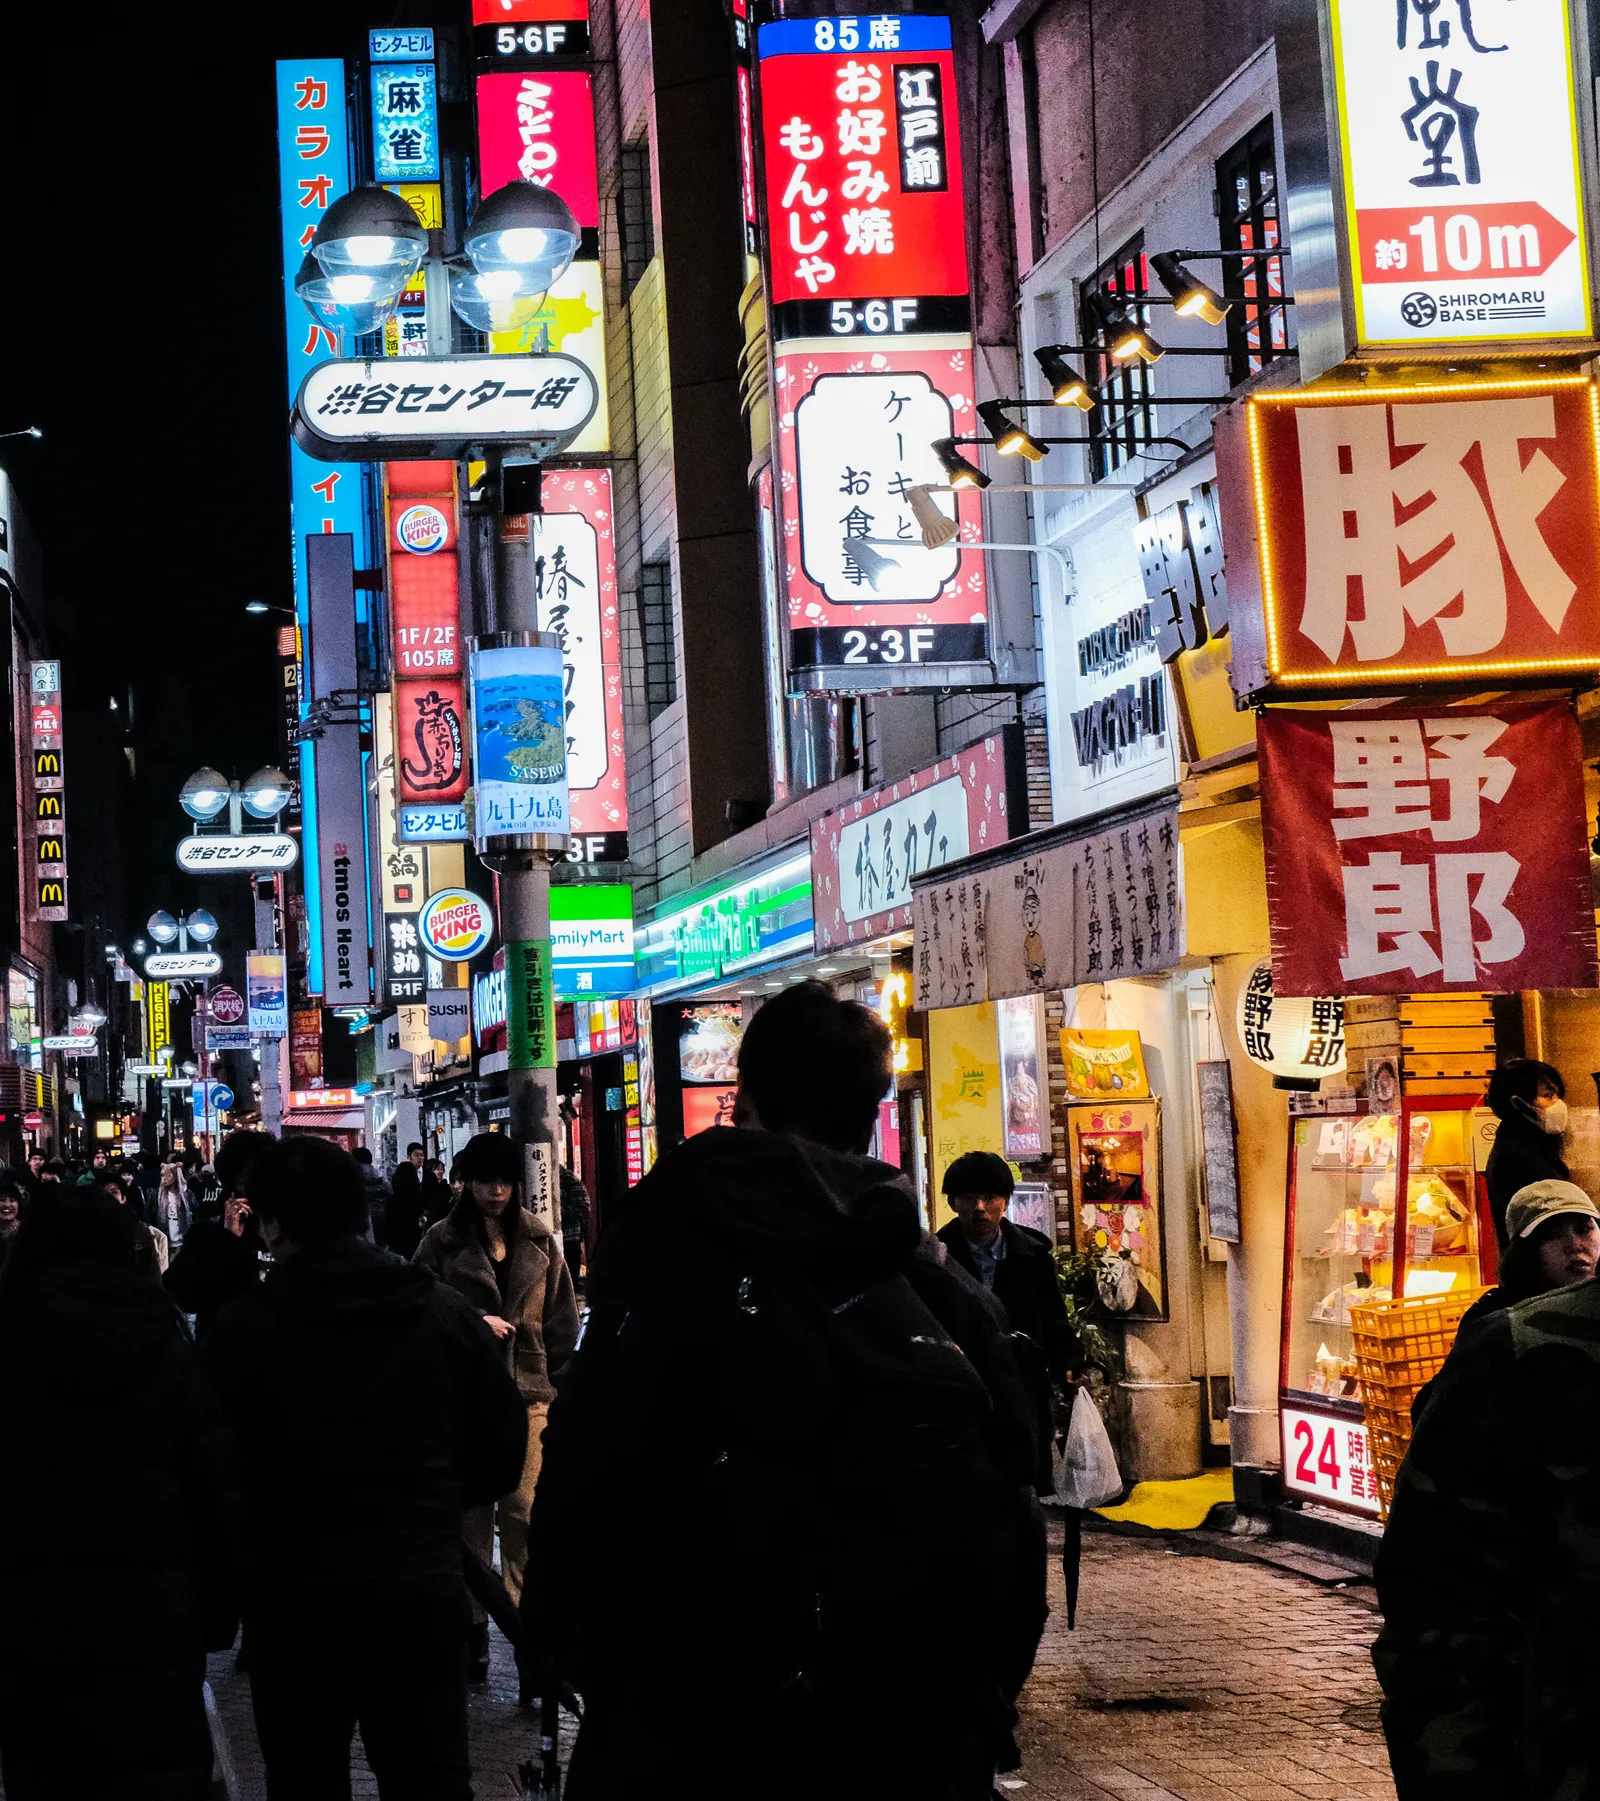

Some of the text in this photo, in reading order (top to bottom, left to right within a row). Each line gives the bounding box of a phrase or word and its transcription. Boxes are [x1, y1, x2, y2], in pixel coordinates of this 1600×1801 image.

[371, 36, 431, 54] センタービル
[814, 19, 901, 50] 85席
[415, 66, 433, 77] 5F
[388, 81, 422, 160] 麻雀
[900, 71, 940, 186] 江戸前
[836, 61, 894, 255] お好み焼
[780, 116, 836, 293] もんじゃ
[404, 293, 420, 301] 4F
[1439, 290, 1545, 308] SHIROMARU
[1439, 308, 1487, 322] BASE
[317, 377, 580, 417] 渋谷センター街
[884, 390, 914, 540] ケーキと
[404, 515, 439, 534] BURGER
[406, 524, 441, 546] KING
[1294, 395, 1577, 665] 豚
[401, 649, 454, 668] 105席
[508, 762, 564, 784] SASEBO
[486, 796, 563, 821] 九十九島
[402, 814, 466, 833] センタービル
[185, 844, 290, 860] 渋谷センター街
[1329, 714, 1526, 983] 野郎
[332, 843, 354, 991] atmos Heart
[429, 903, 479, 926] BURGER
[433, 916, 482, 946] KING
[550, 929, 625, 945] amilyMart
[149, 959, 217, 970] 渋谷センター街
[391, 982, 422, 996] B1F
[576, 972, 593, 989] 酒
[214, 999, 243, 1012] 消火栓
[428, 1003, 468, 1017] SUSHI
[1294, 1420, 1341, 1490] 24
